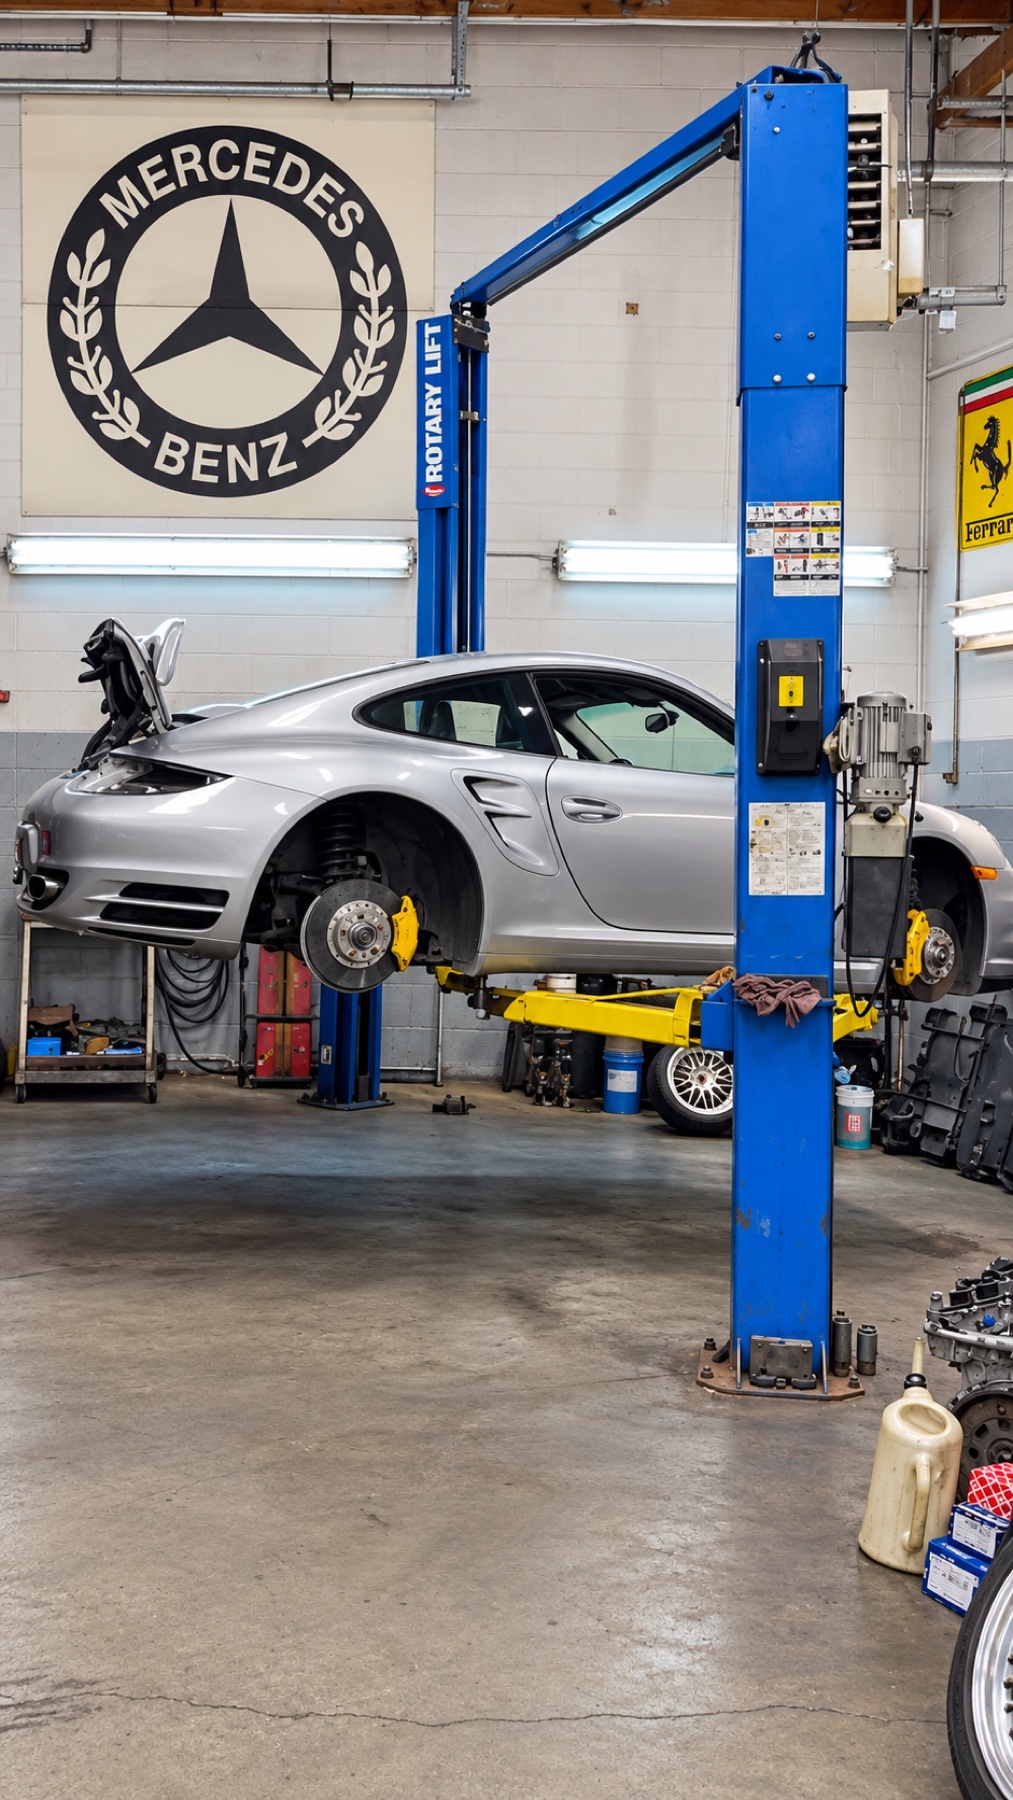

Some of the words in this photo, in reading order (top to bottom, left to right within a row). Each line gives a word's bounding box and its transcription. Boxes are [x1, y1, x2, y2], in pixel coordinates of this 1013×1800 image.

[99, 139, 365, 238] MERCEDES
[424, 322, 442, 375] LIFT
[153, 431, 298, 484] BENZ
[425, 382, 443, 483] ROTARY
